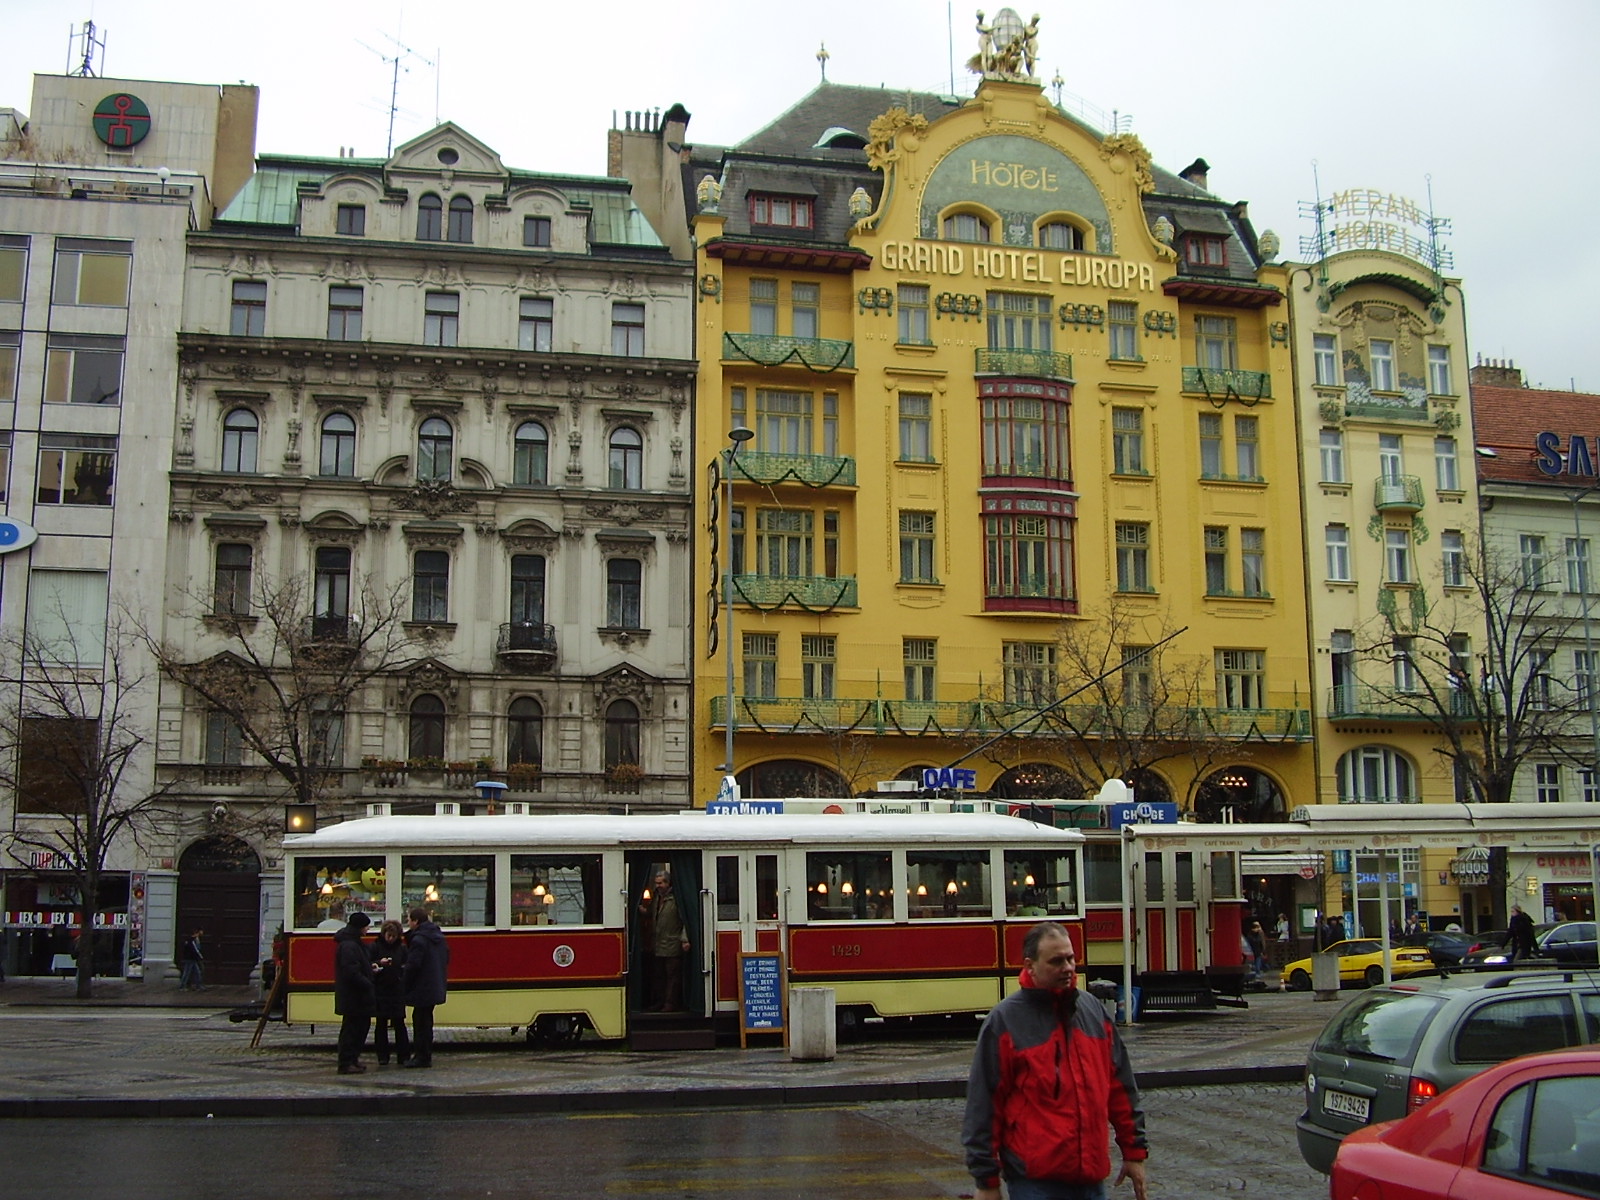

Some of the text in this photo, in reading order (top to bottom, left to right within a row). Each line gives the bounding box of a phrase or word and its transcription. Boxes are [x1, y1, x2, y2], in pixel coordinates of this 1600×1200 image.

[1333, 188, 1419, 227] MERAN
[1335, 220, 1419, 260] HOTEL
[881, 240, 1154, 291] GRAND HOTEL EUROPA
[1536, 431, 1600, 477] SA
[713, 803, 776, 815] TRAMVAJ
[1220, 805, 1233, 824] 11
[31, 852, 71, 869] DUPLEX
[1356, 872, 1398, 884] CHAGE
[832, 945, 860, 956] 1429
